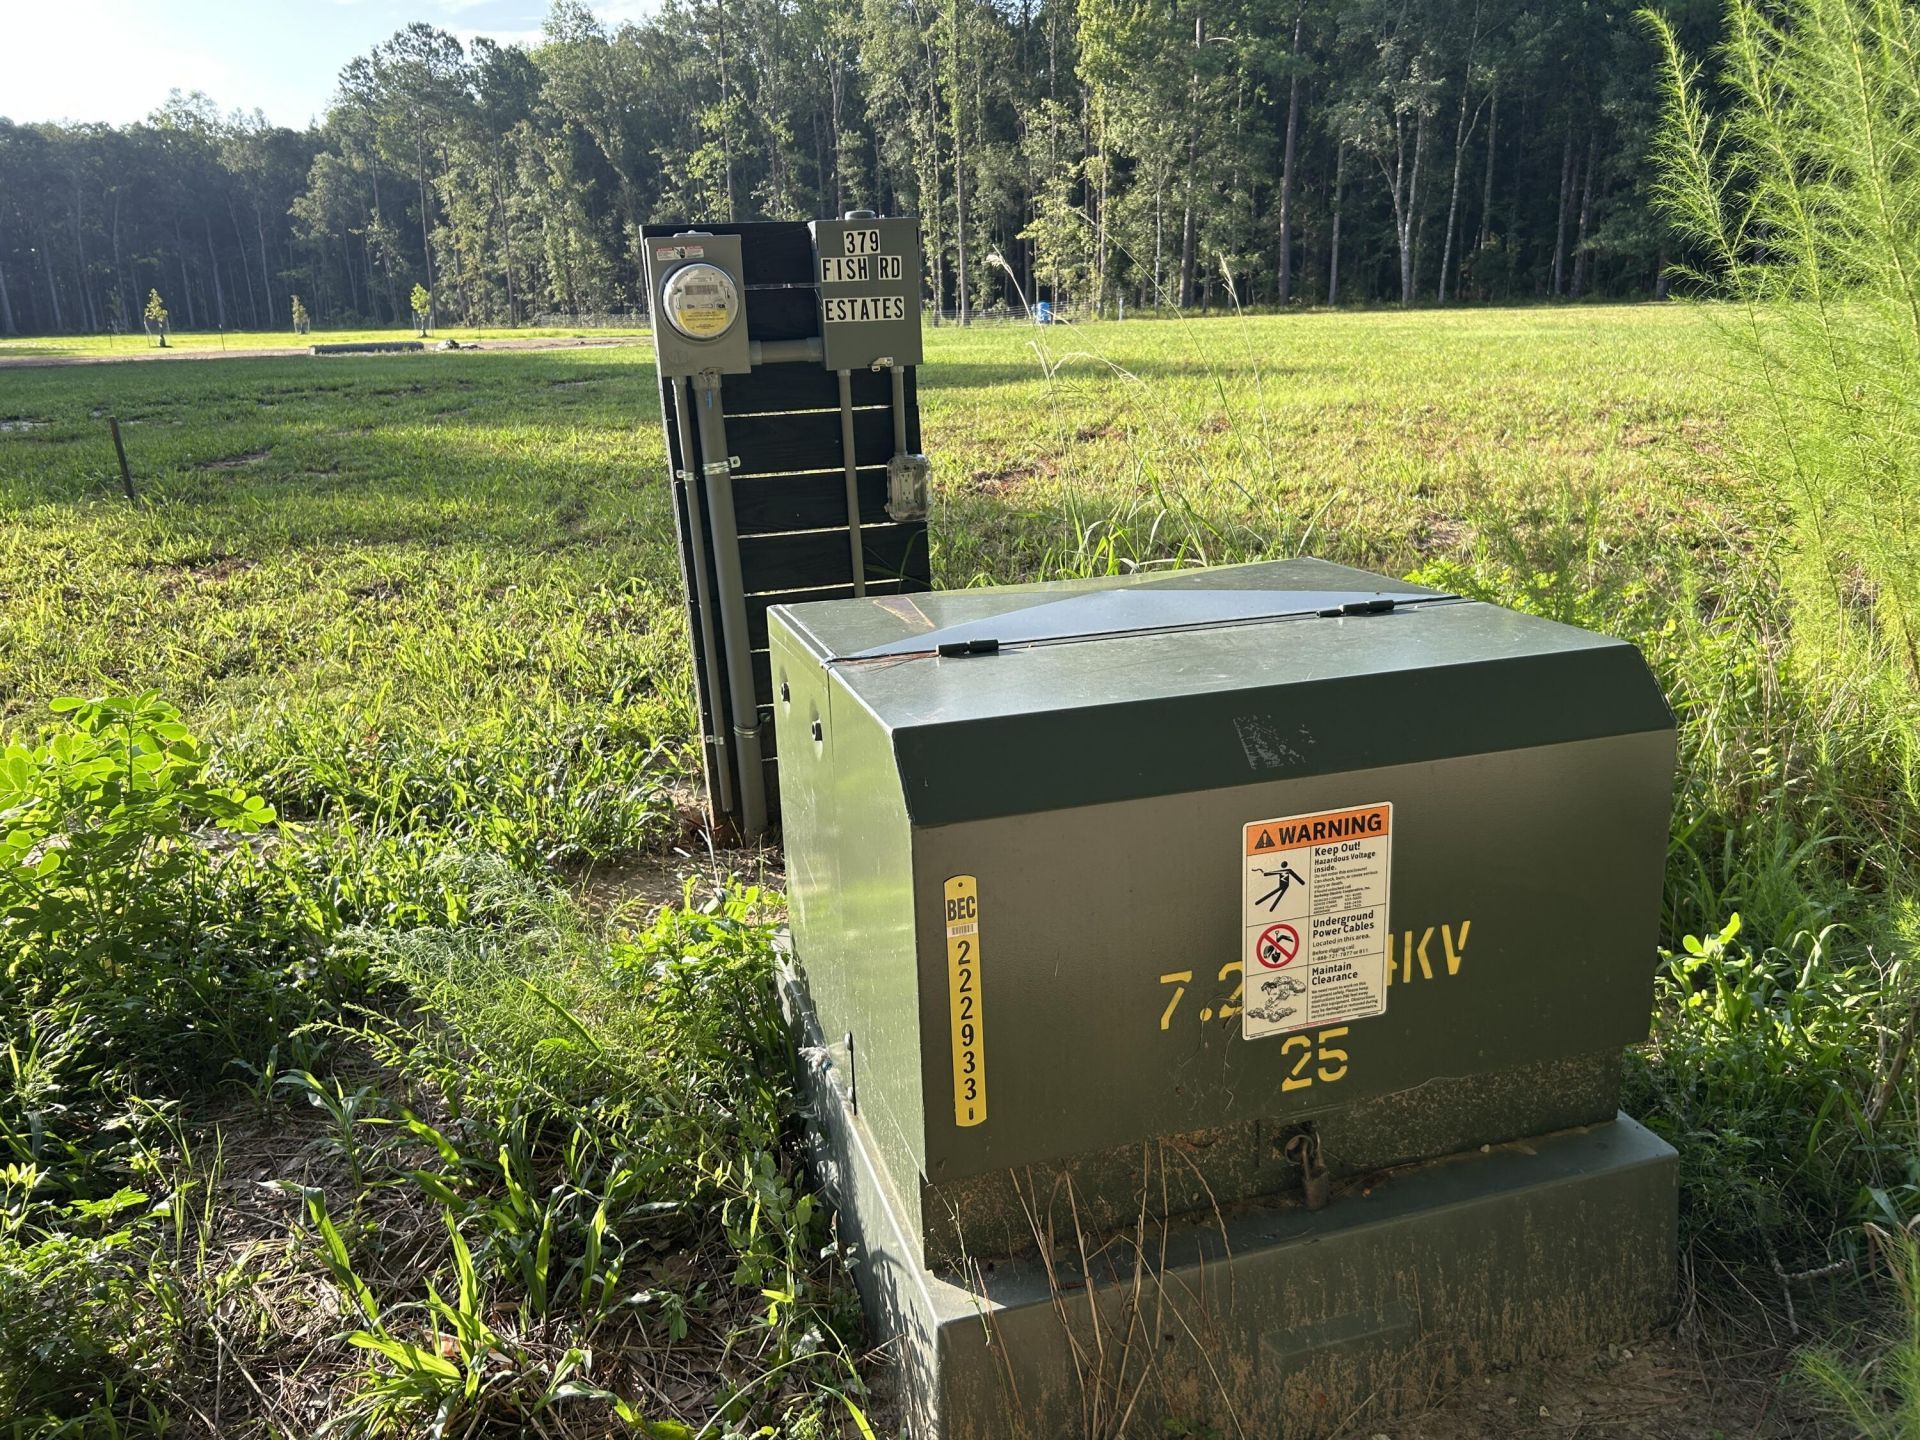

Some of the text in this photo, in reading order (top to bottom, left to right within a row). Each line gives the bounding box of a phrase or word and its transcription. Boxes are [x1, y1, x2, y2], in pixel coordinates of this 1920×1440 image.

[845, 230, 879, 254] 379
[822, 257, 901, 281] FISH RD
[824, 297, 904, 321] ESTATES
[1278, 813, 1382, 846] WARNING
[1314, 841, 1361, 857] Keep Out!
[1314, 851, 1376, 866] Hazardous Voltage
[1314, 864, 1337, 873] inside.
[946, 895, 976, 921] BEC
[1313, 909, 1374, 928] Underground
[1312, 921, 1375, 938] Power Cables
[1312, 938, 1336, 947] Located
[1312, 962, 1352, 976] Maintain
[1312, 971, 1358, 986] Clearance
[957, 940, 977, 1100] 222933
[1281, 1027, 1349, 1092] 25
